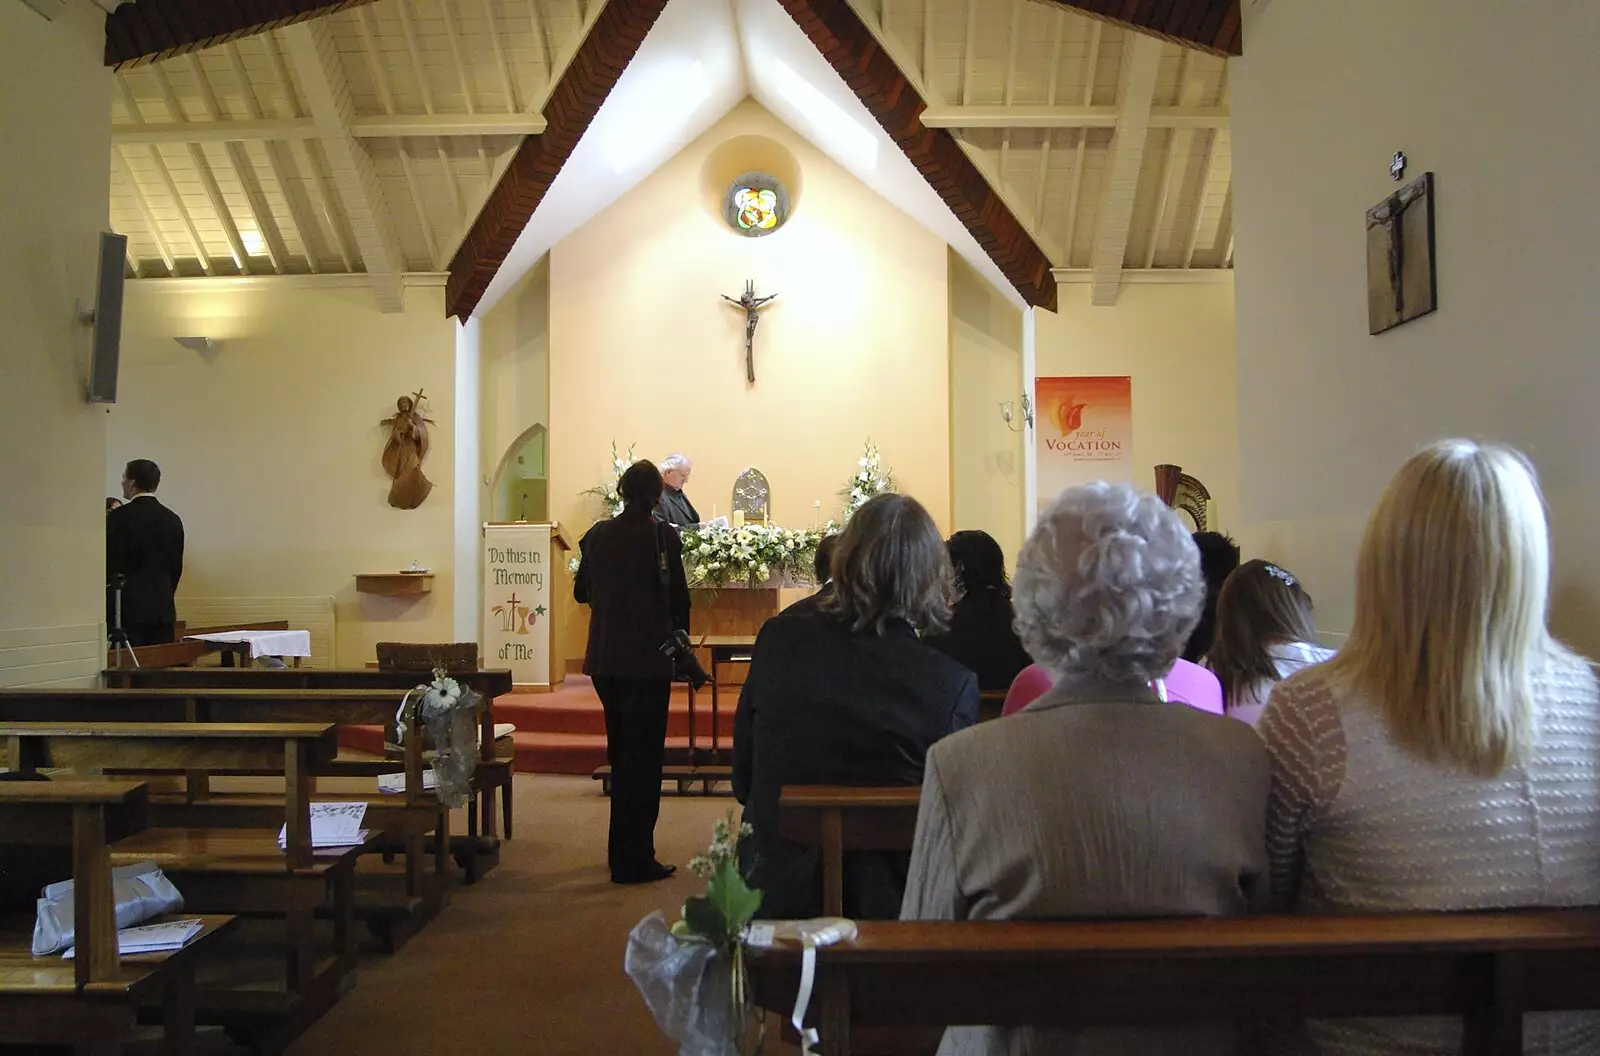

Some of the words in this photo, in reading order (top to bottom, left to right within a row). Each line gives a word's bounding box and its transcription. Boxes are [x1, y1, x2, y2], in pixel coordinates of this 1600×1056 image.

[1075, 431, 1094, 440] year
[1097, 427, 1107, 440] of
[488, 547, 505, 564] Do
[507, 548, 527, 564] this
[528, 548, 541, 564] in
[493, 568, 543, 591] Memory
[498, 642, 512, 660] of
[512, 643, 533, 660] Me
